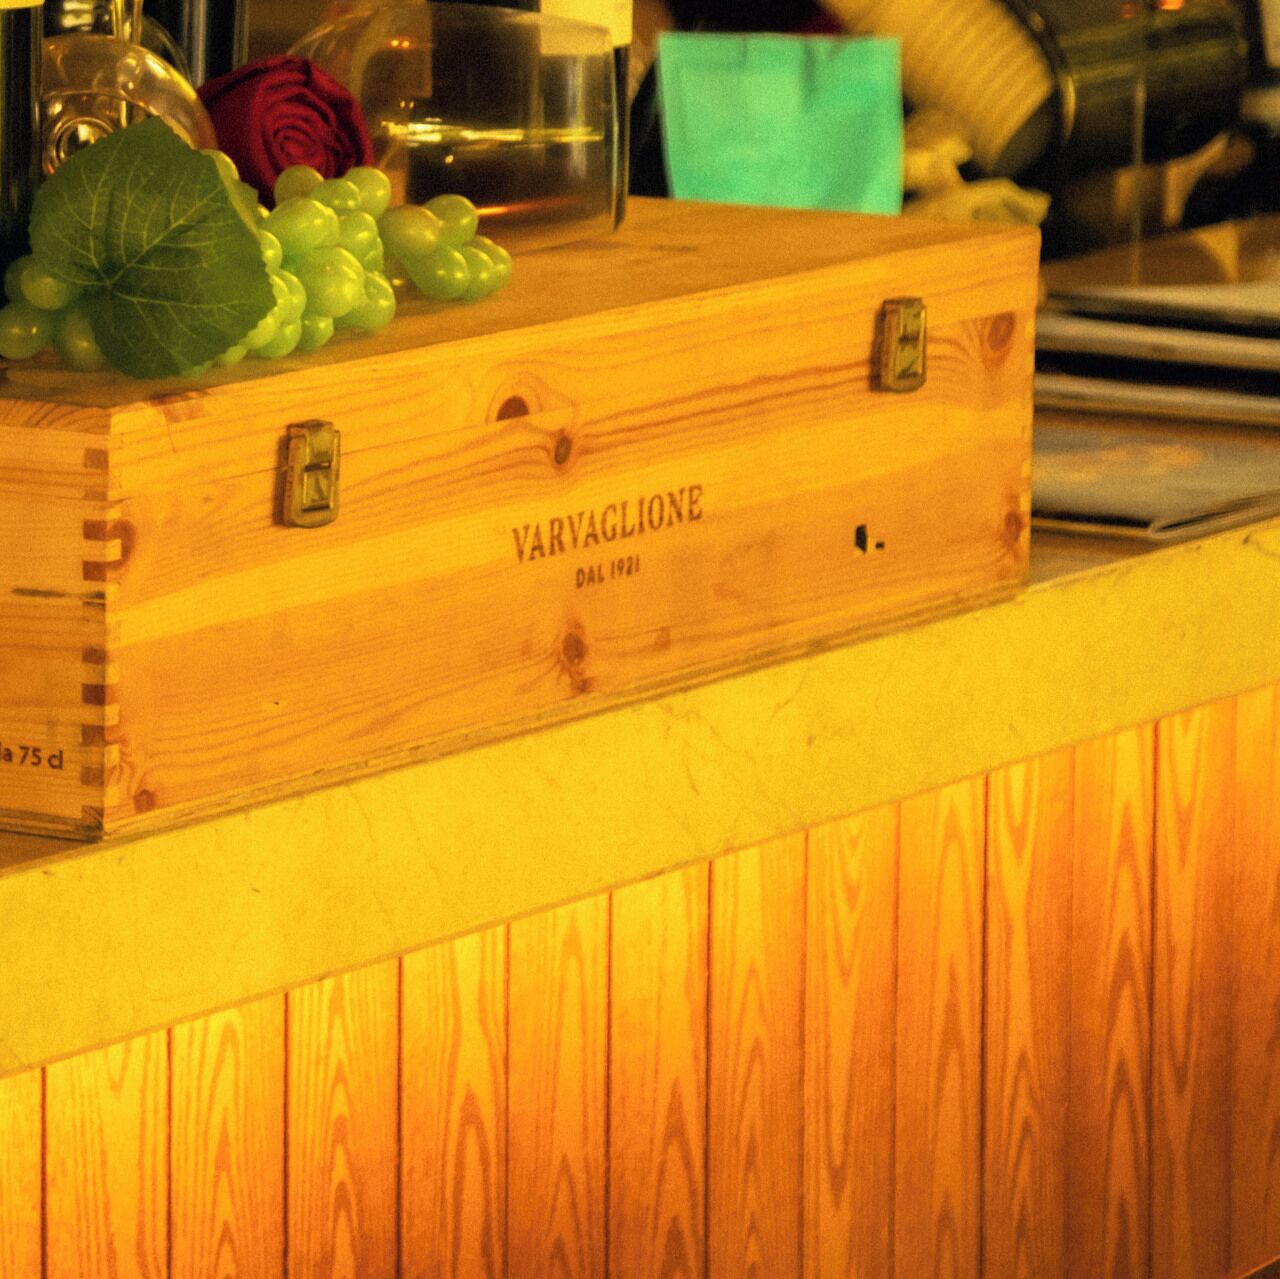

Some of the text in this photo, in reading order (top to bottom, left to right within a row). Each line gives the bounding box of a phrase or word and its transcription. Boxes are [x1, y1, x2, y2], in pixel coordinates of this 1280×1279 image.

[512, 483, 704, 565] VARVAGLIONE
[575, 562, 606, 589] DAL
[18, 745, 43, 767] 75
[47, 749, 65, 771] cl
